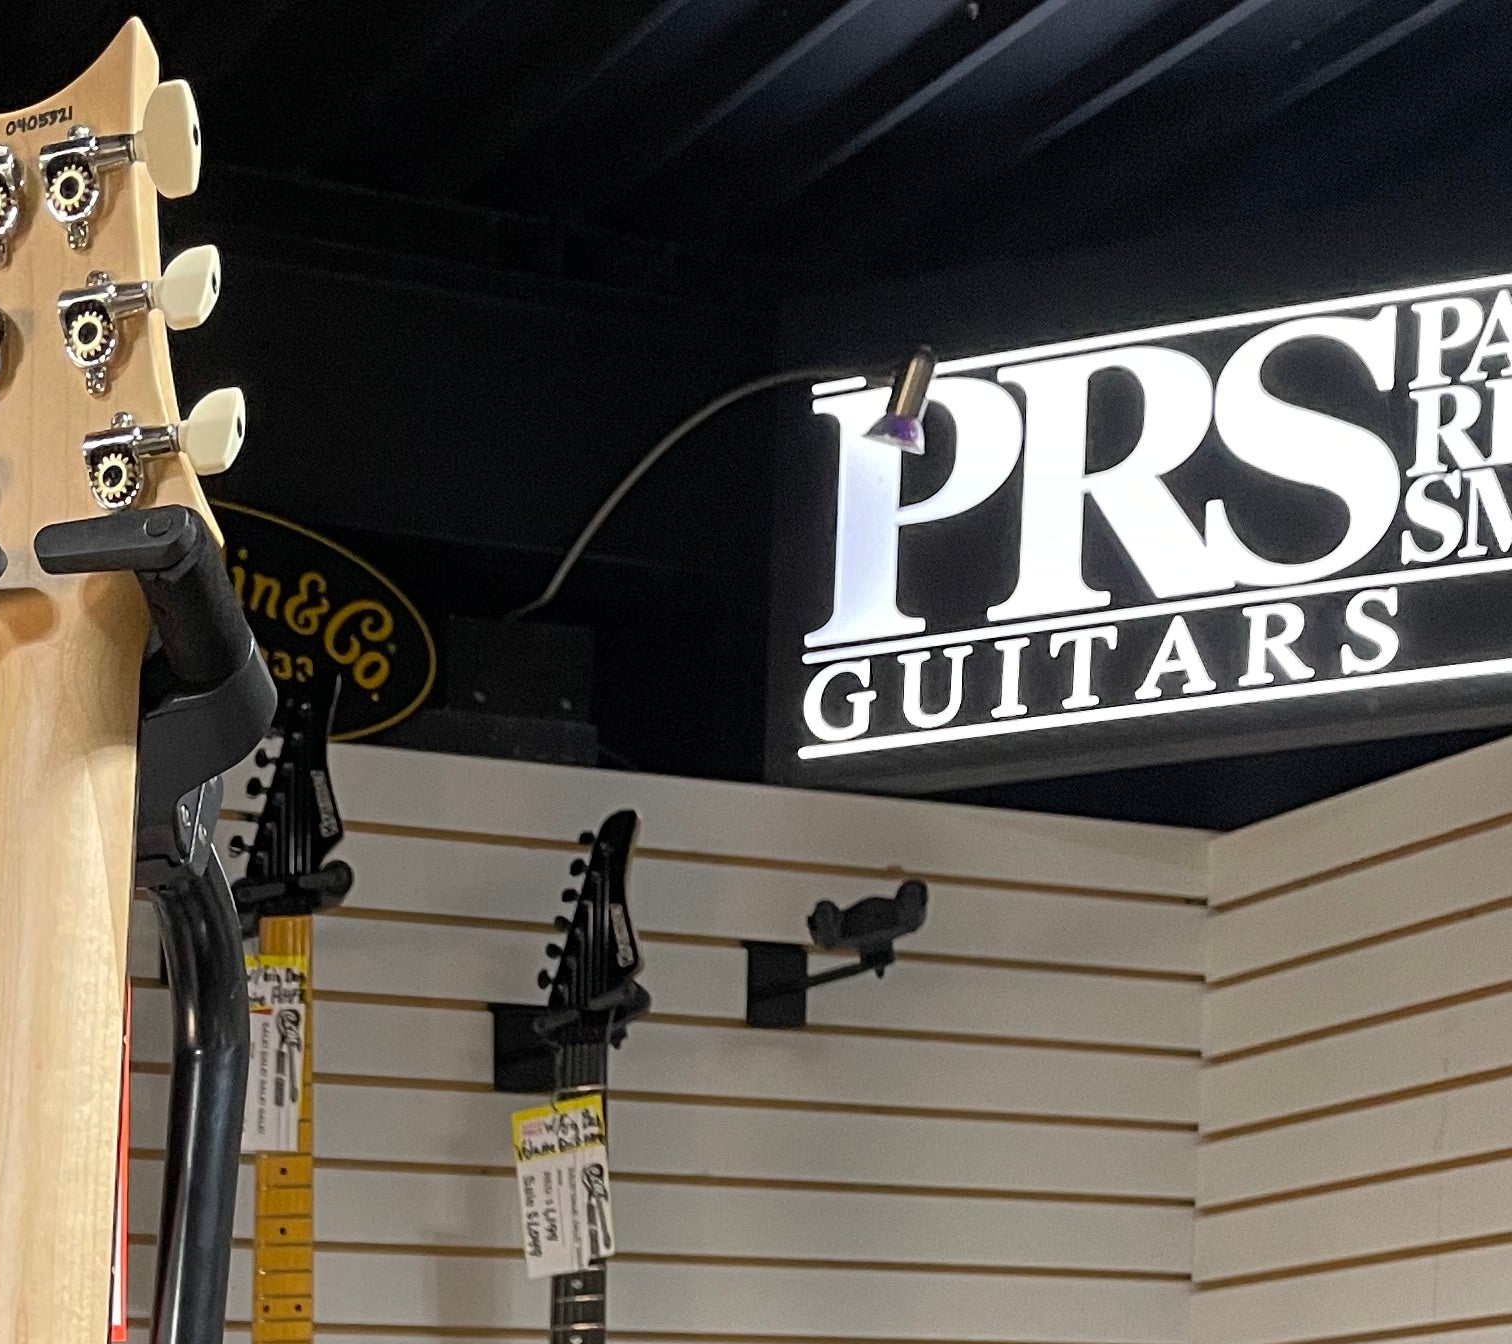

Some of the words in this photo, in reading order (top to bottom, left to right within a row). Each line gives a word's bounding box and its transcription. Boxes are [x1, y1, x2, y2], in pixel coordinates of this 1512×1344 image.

[1408, 288, 1512, 390] PA
[803, 304, 1401, 648] PRS
[802, 587, 1402, 743] GUITARS
